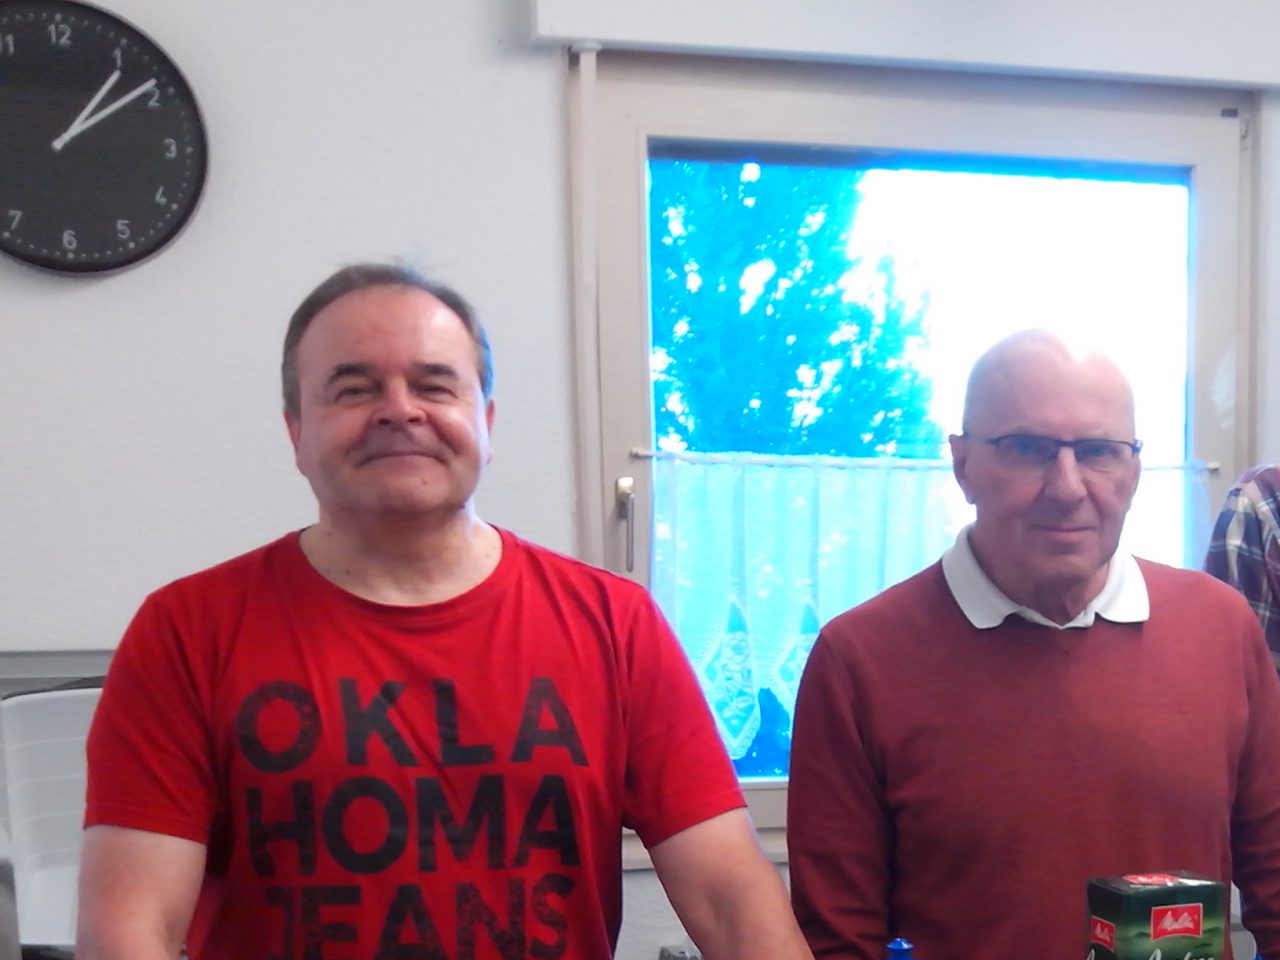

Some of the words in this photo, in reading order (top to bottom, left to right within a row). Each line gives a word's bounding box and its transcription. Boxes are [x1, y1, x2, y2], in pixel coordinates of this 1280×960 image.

[48, 24, 71, 47] 12
[112, 47, 122, 68] 1
[147, 85, 161, 107] 2
[164, 138, 178, 158] 3
[155, 186, 168, 204] 4
[8, 209, 23, 230] 7
[116, 219, 131, 239] 5
[62, 230, 77, 250] 6
[235, 677, 590, 774] OKLA
[244, 773, 582, 877] HOMA
